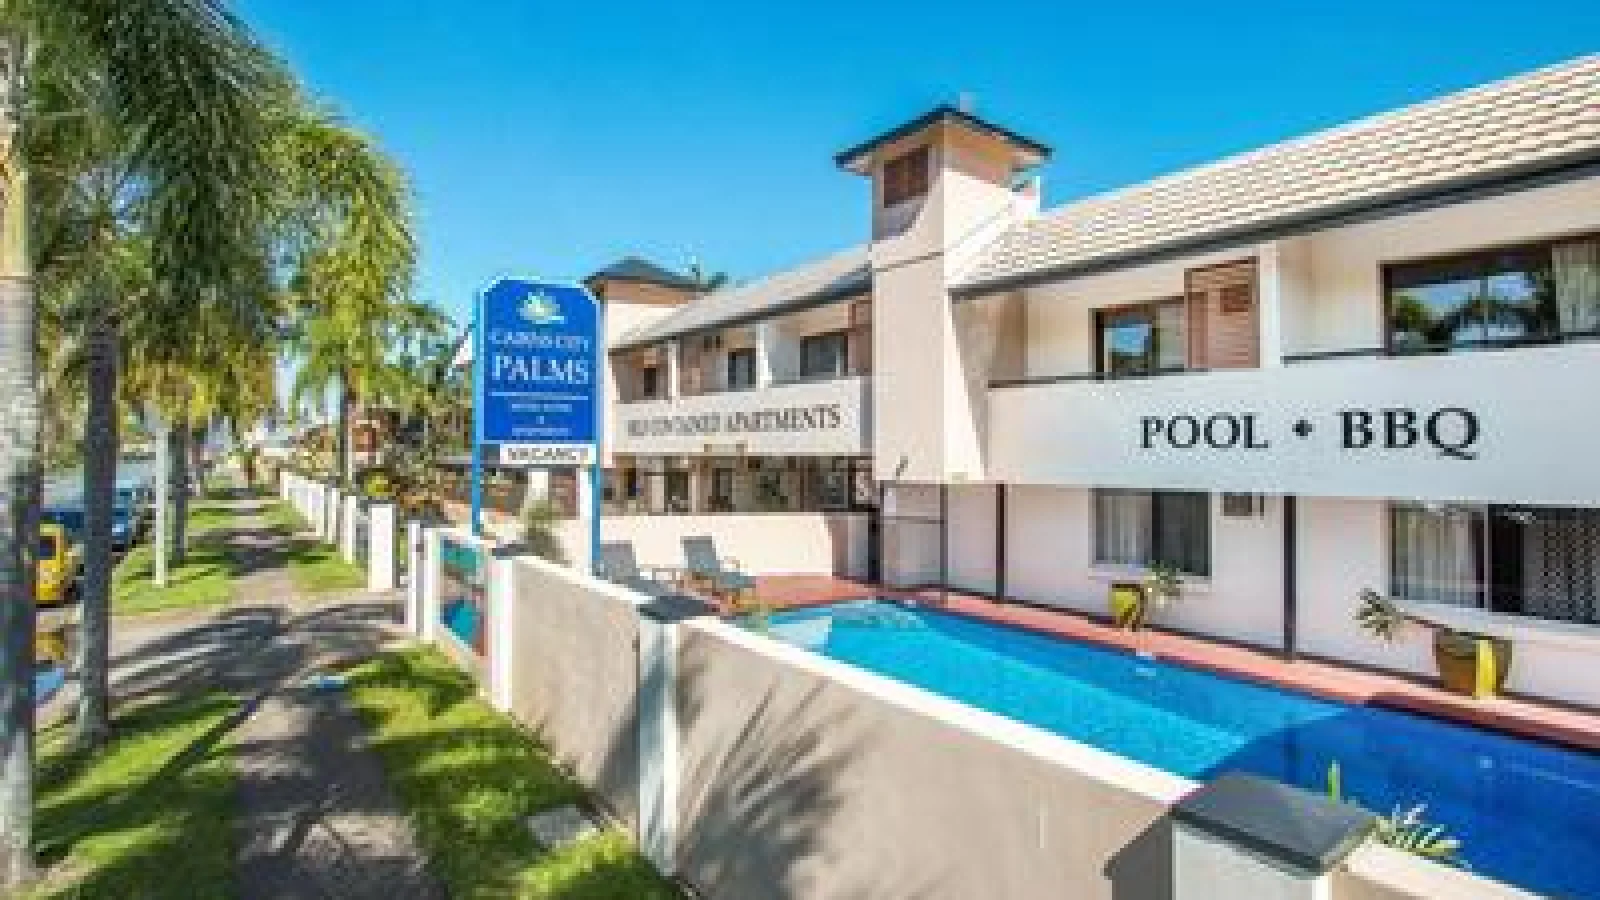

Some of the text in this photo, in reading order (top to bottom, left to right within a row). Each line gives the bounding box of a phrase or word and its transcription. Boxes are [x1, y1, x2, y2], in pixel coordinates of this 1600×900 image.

[491, 354, 589, 385] PALMS
[724, 402, 841, 434] APARTMENTS
[1138, 407, 1481, 461] POOL BBQ
